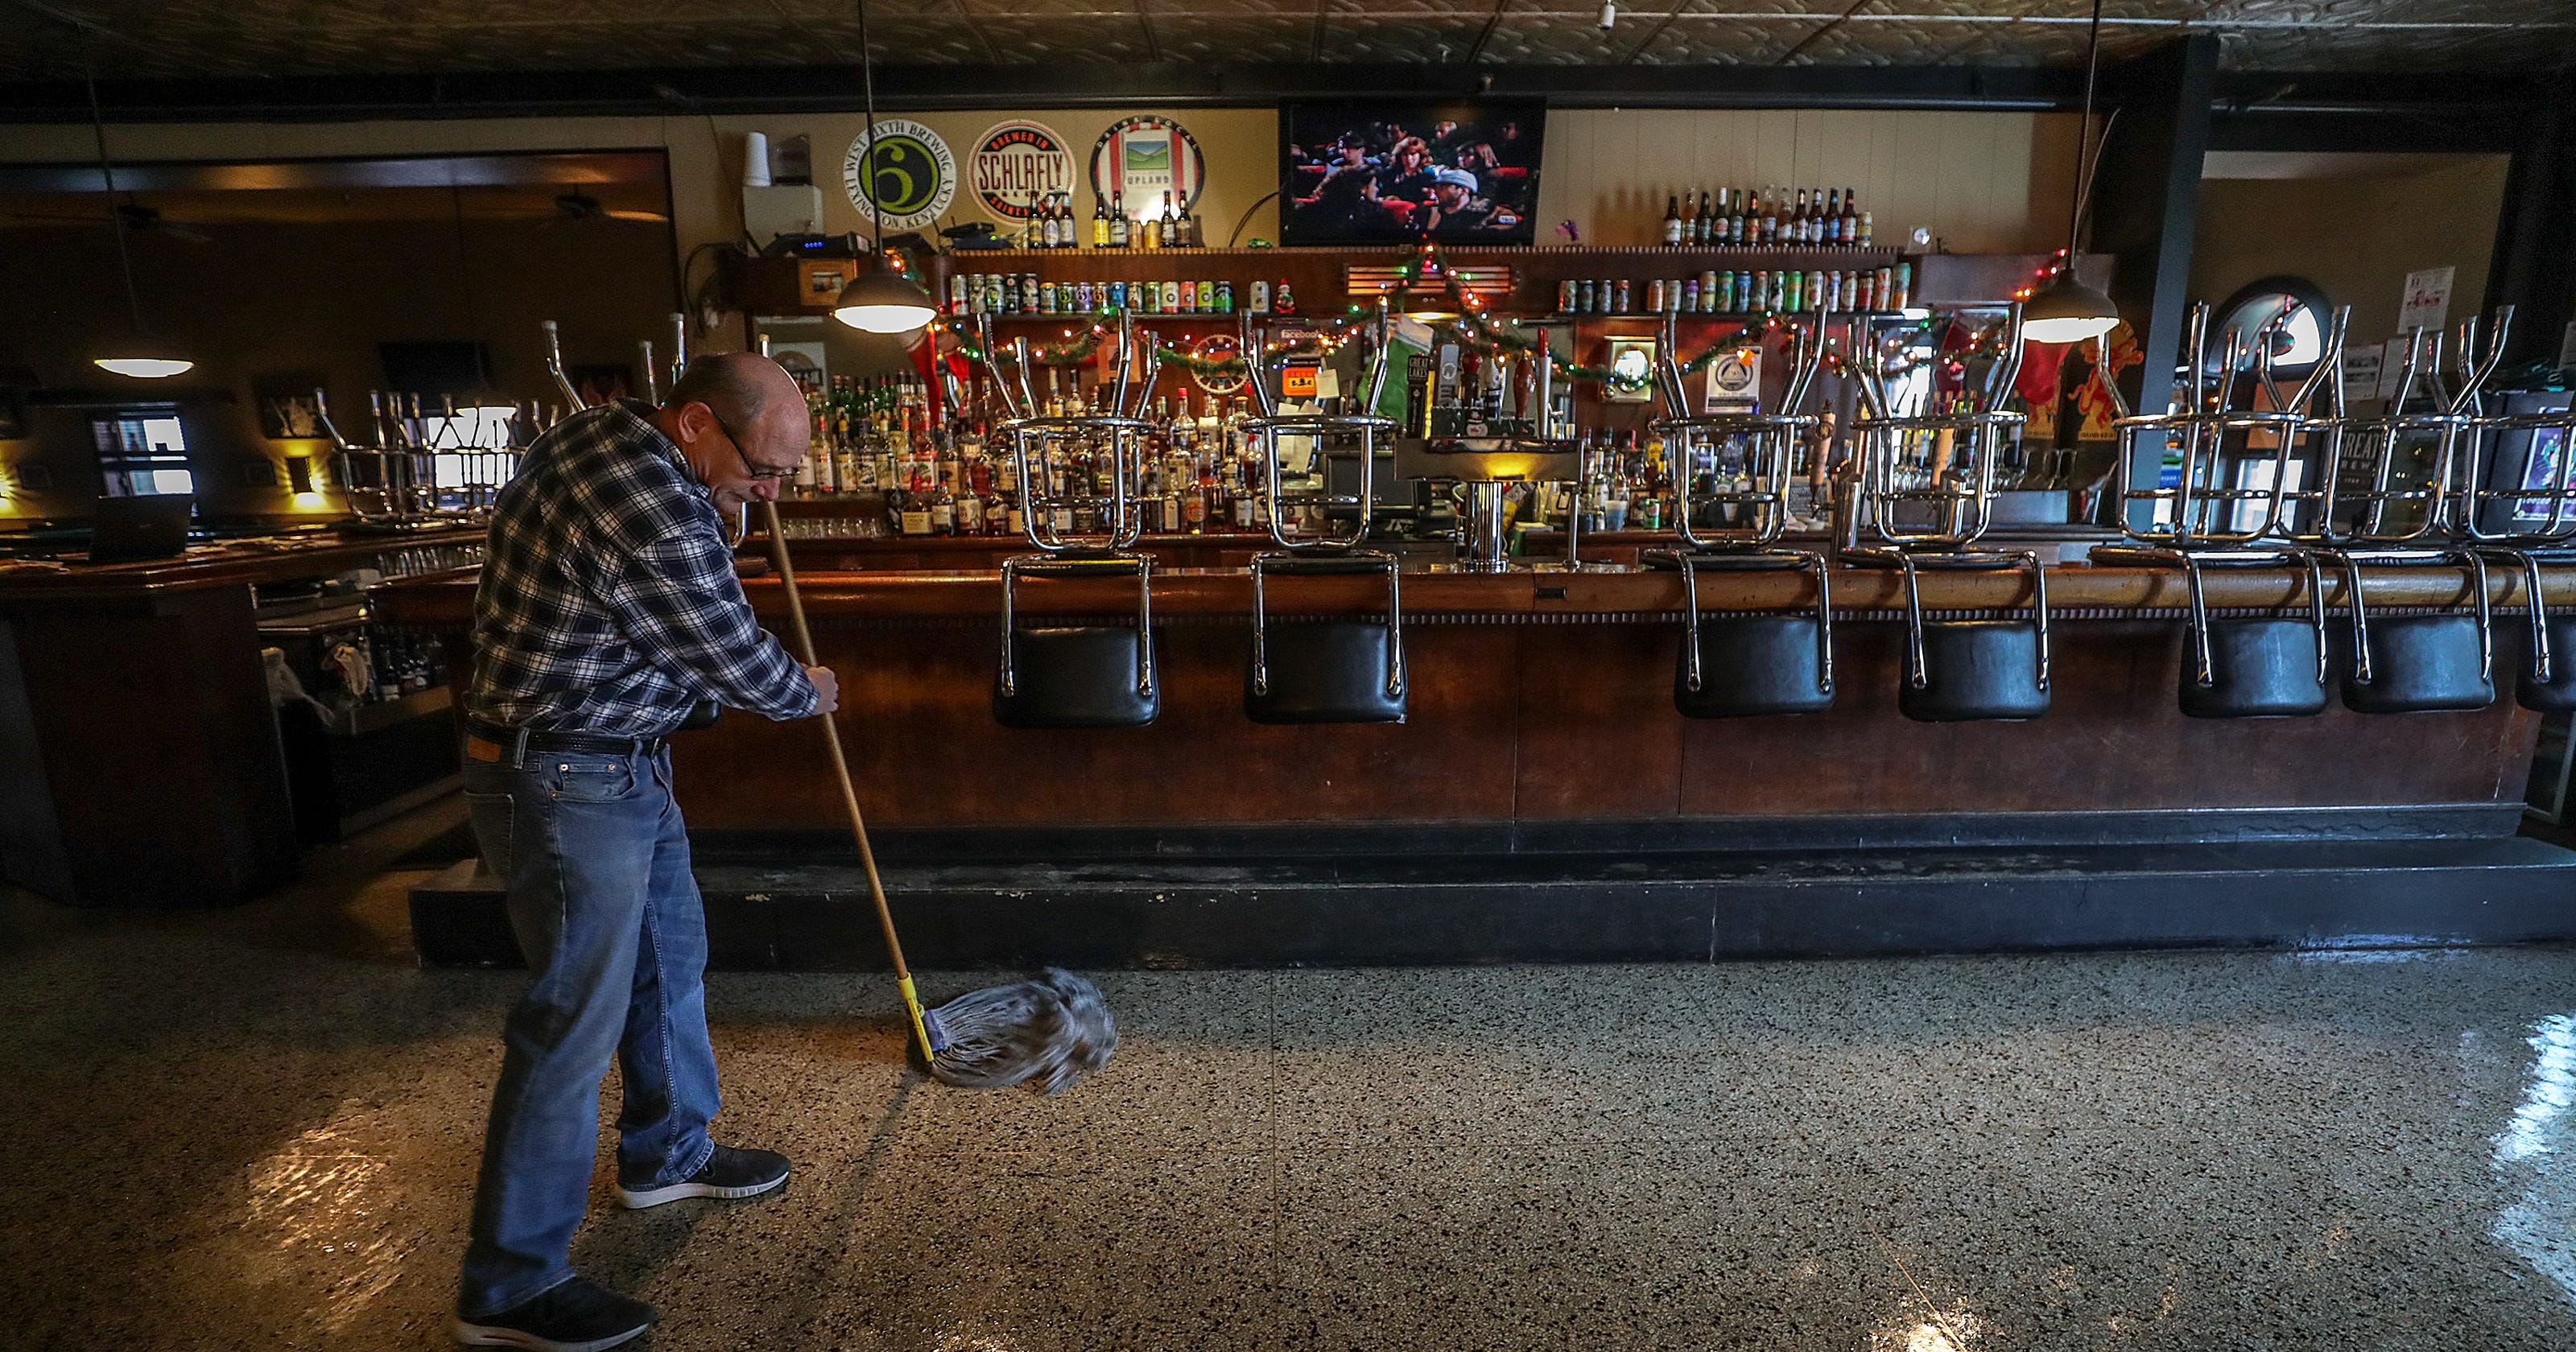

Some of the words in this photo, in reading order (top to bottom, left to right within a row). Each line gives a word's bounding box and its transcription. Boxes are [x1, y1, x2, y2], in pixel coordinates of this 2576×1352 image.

[845, 138, 867, 172] WEST
[872, 121, 905, 138] IXTH
[909, 122, 952, 171] BREWING
[990, 131, 1035, 150] BREWED
[1035, 137, 1049, 149] IN
[1154, 117, 1198, 149] LOCAL
[978, 153, 1063, 190] SCHLAFLY
[1127, 175, 1170, 185] UPLAND
[845, 177, 903, 229] LEXINGON,
[906, 178, 953, 229] KENTUCKY
[989, 196, 1022, 216] SAINT
[2340, 432, 2383, 460] REAT
